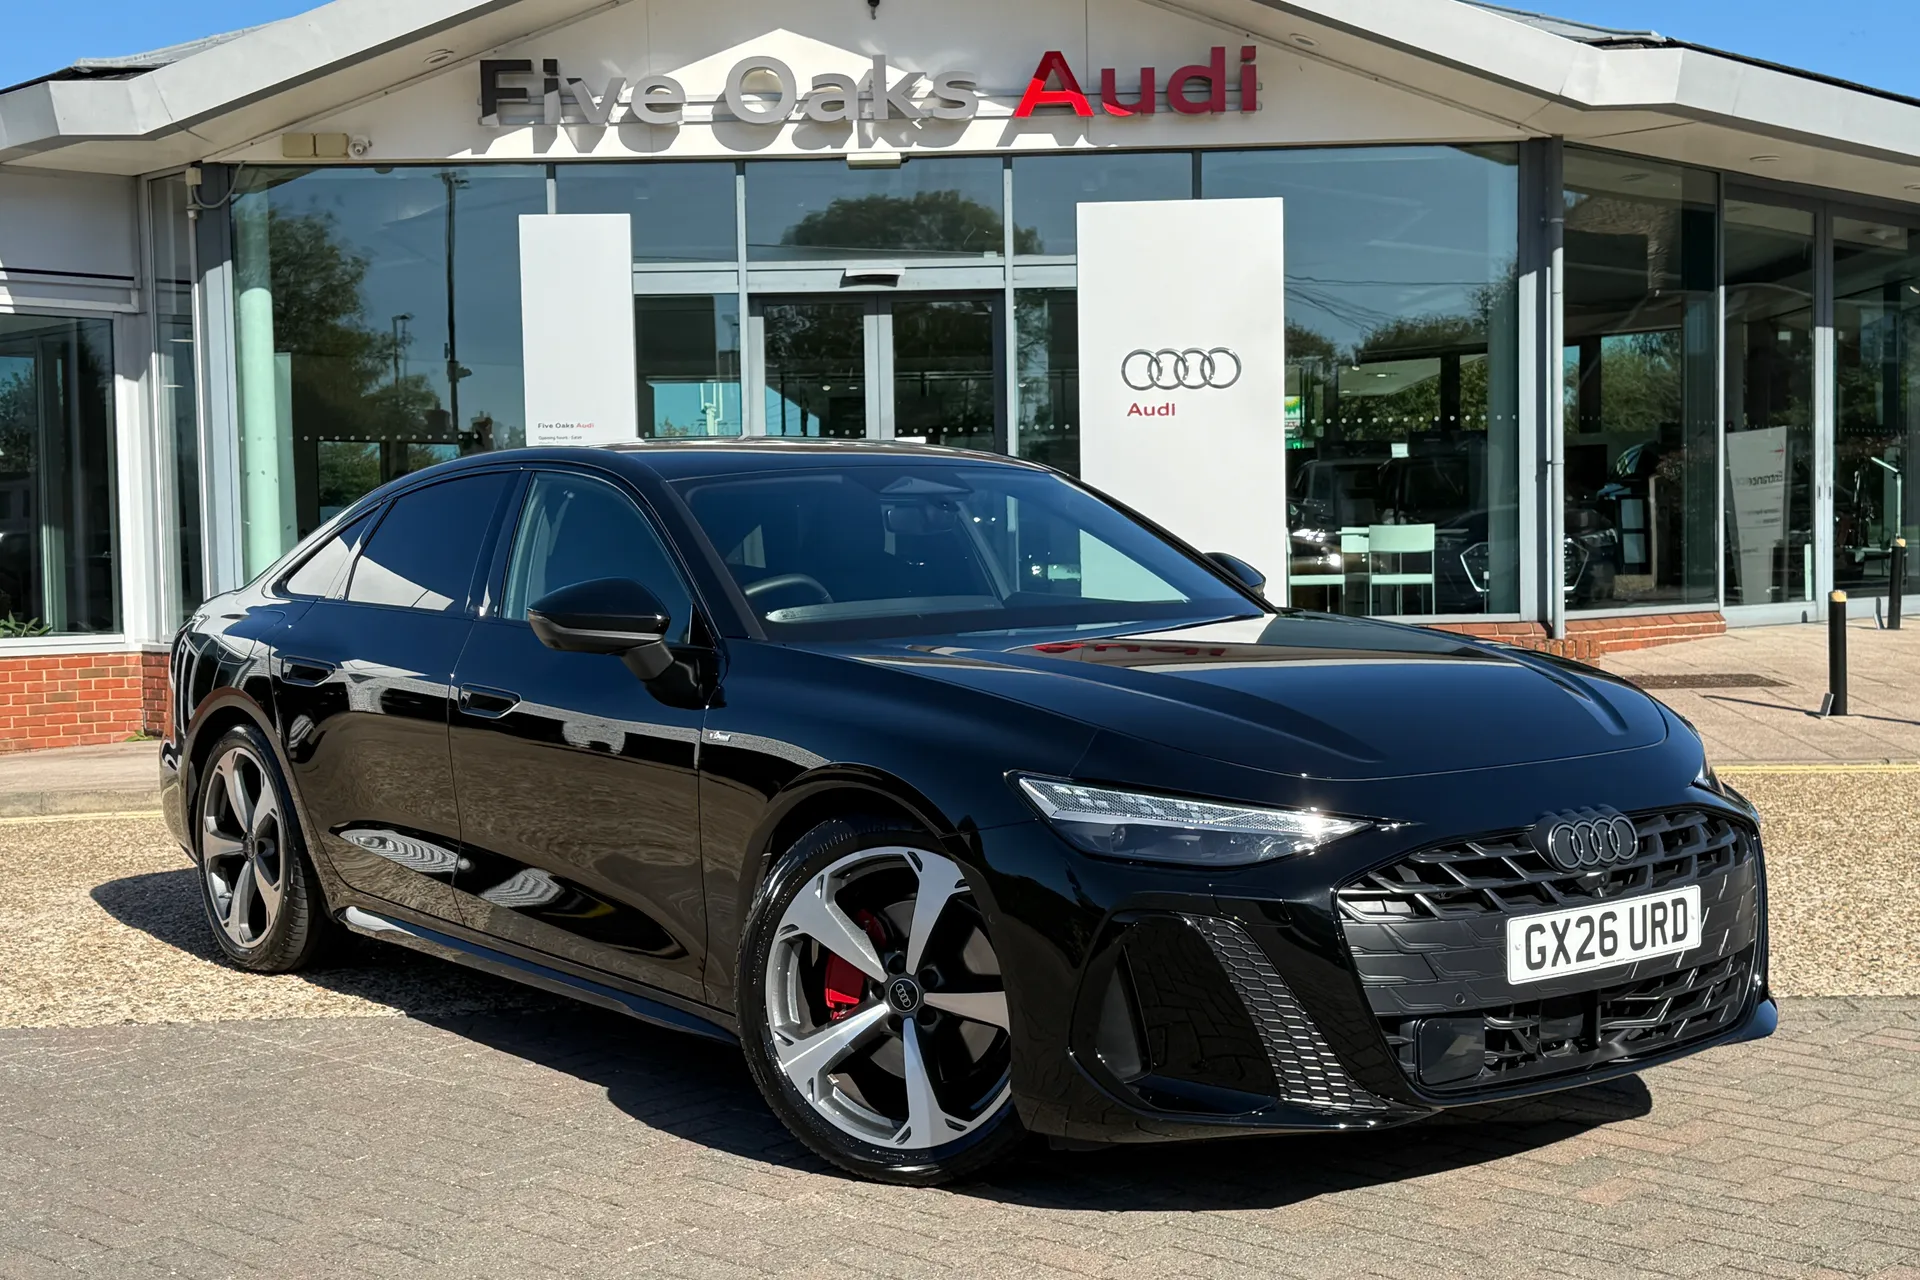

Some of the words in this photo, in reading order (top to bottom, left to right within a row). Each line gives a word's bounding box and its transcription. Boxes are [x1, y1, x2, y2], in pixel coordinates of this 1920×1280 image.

[480, 58, 688, 126] Five
[725, 54, 980, 125] Oaks
[1013, 45, 1258, 118] Audi
[1126, 402, 1176, 417] Audi
[1524, 911, 1618, 970] GX26
[1628, 897, 1689, 951] URD
